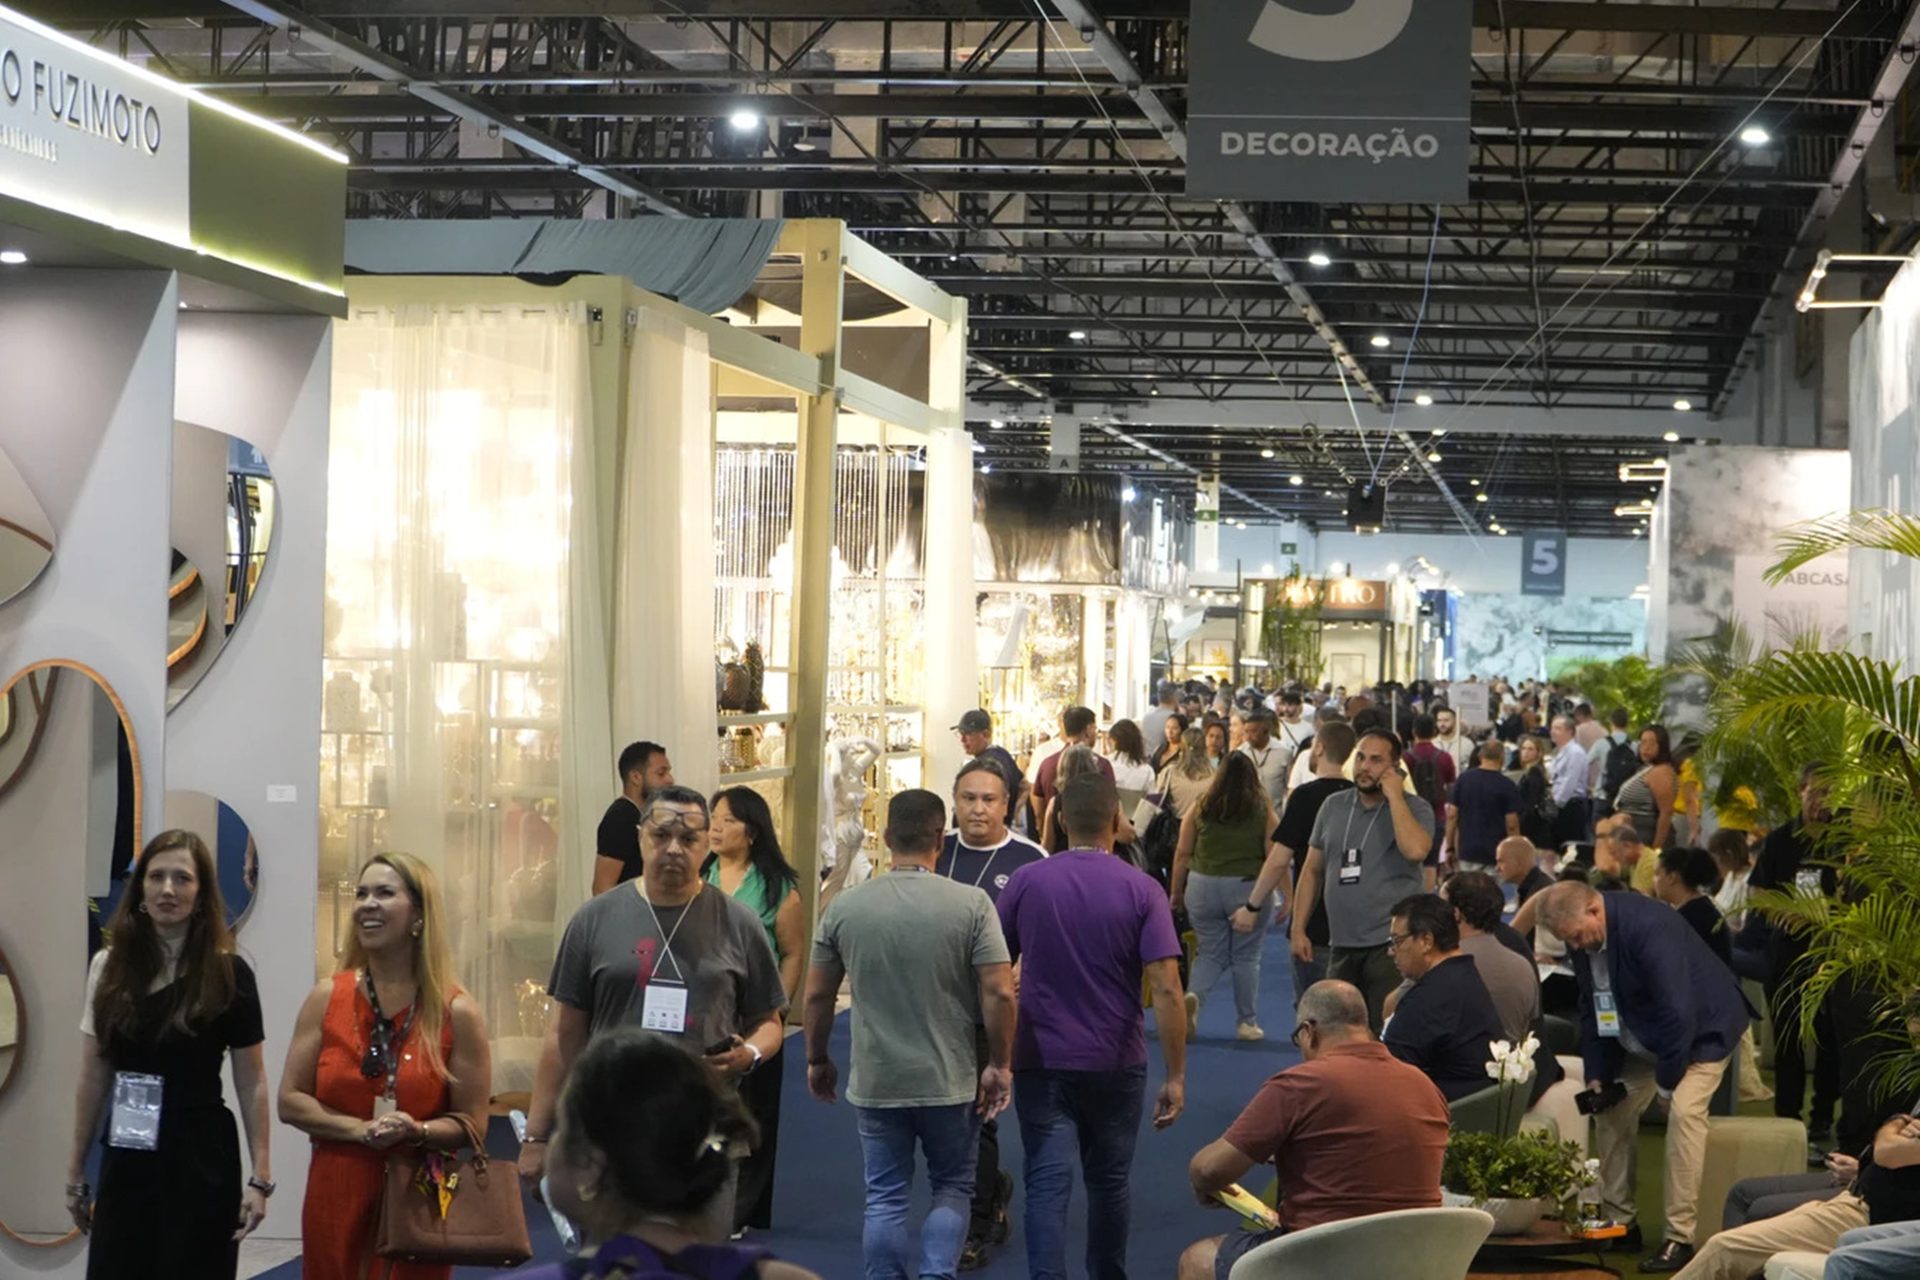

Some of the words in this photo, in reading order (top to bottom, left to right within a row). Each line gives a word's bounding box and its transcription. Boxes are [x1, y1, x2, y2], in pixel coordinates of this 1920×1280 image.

[33, 60, 161, 155] FUZIMOTO
[1220, 127, 1440, 164] DECORAÇÃO
[1530, 539, 1559, 575] 5
